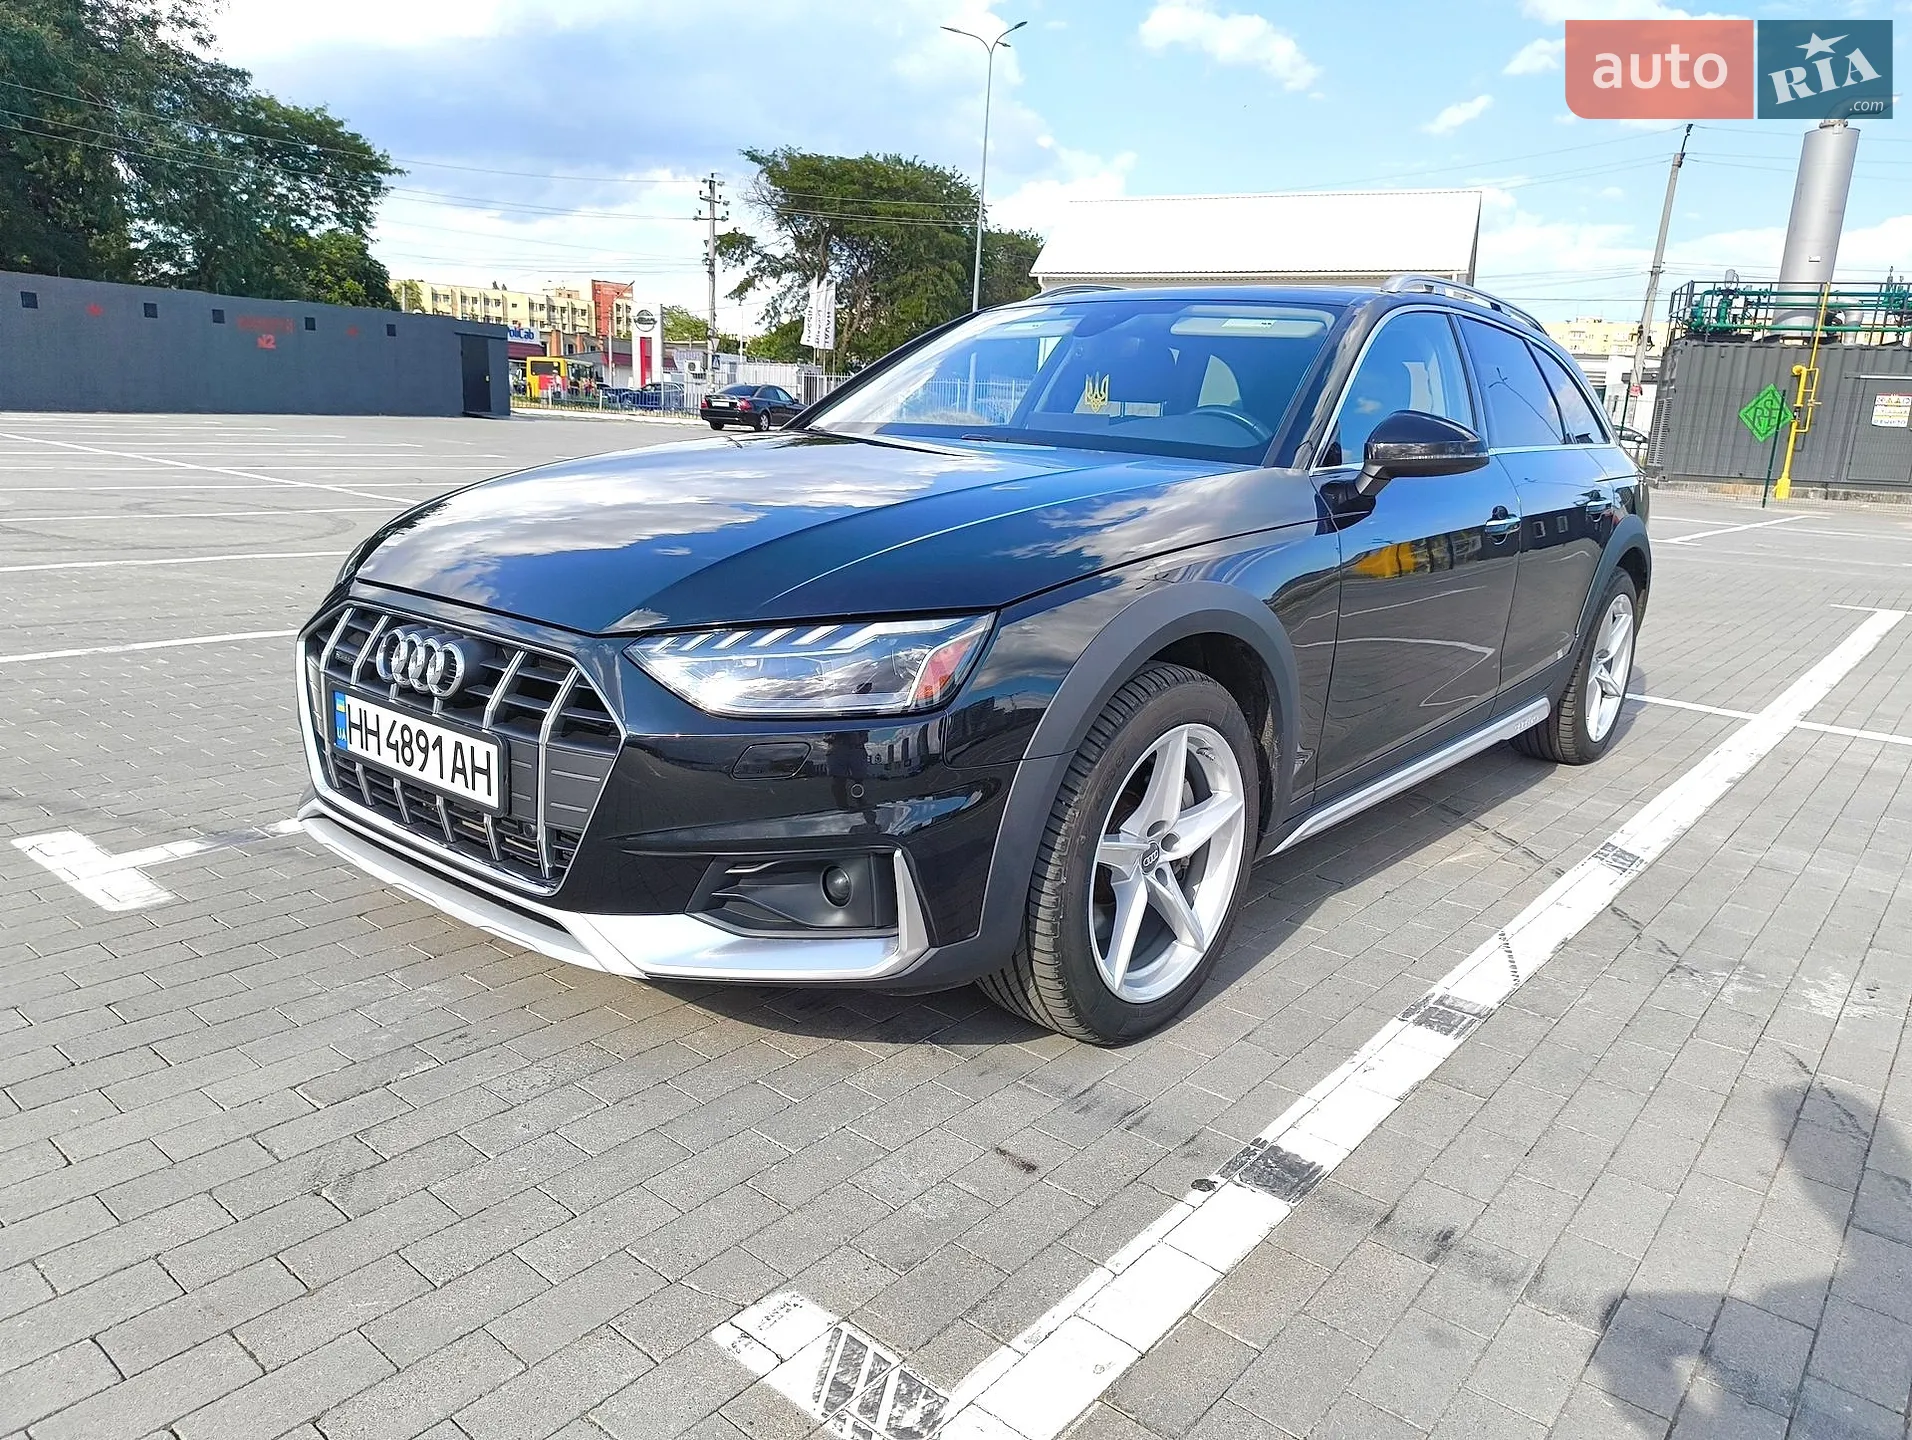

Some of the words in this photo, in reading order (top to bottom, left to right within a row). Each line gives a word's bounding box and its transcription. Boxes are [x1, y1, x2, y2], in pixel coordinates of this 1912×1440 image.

[337, 726, 347, 741] UA
[386, 719, 444, 780] 4891
[450, 740, 491, 797] AH
